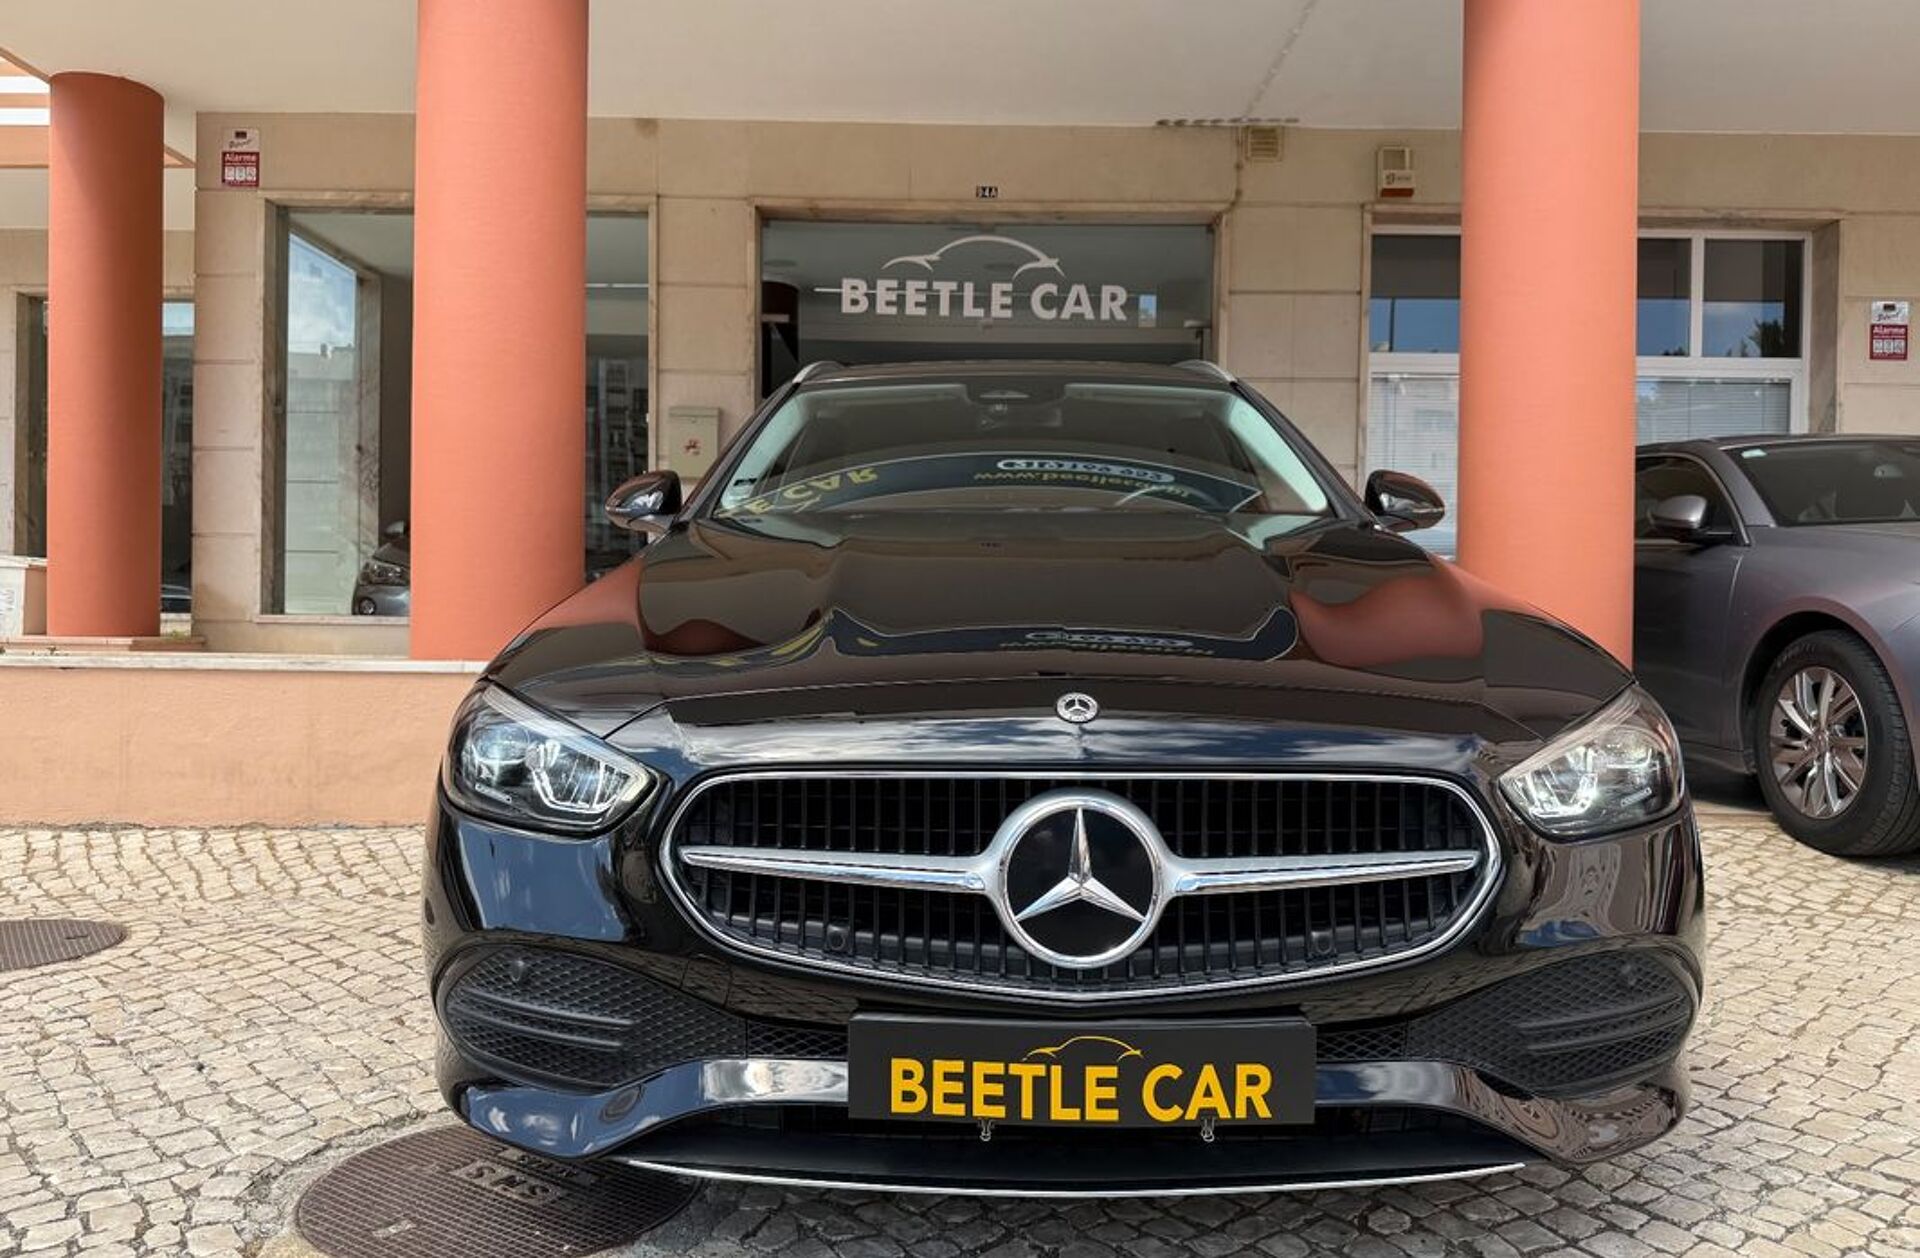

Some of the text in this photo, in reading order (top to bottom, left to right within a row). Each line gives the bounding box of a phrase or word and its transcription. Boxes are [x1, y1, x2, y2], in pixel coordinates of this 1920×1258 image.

[840, 278, 1128, 321] BEETLE CAR
[891, 1057, 1273, 1122] BEETLE CAR
